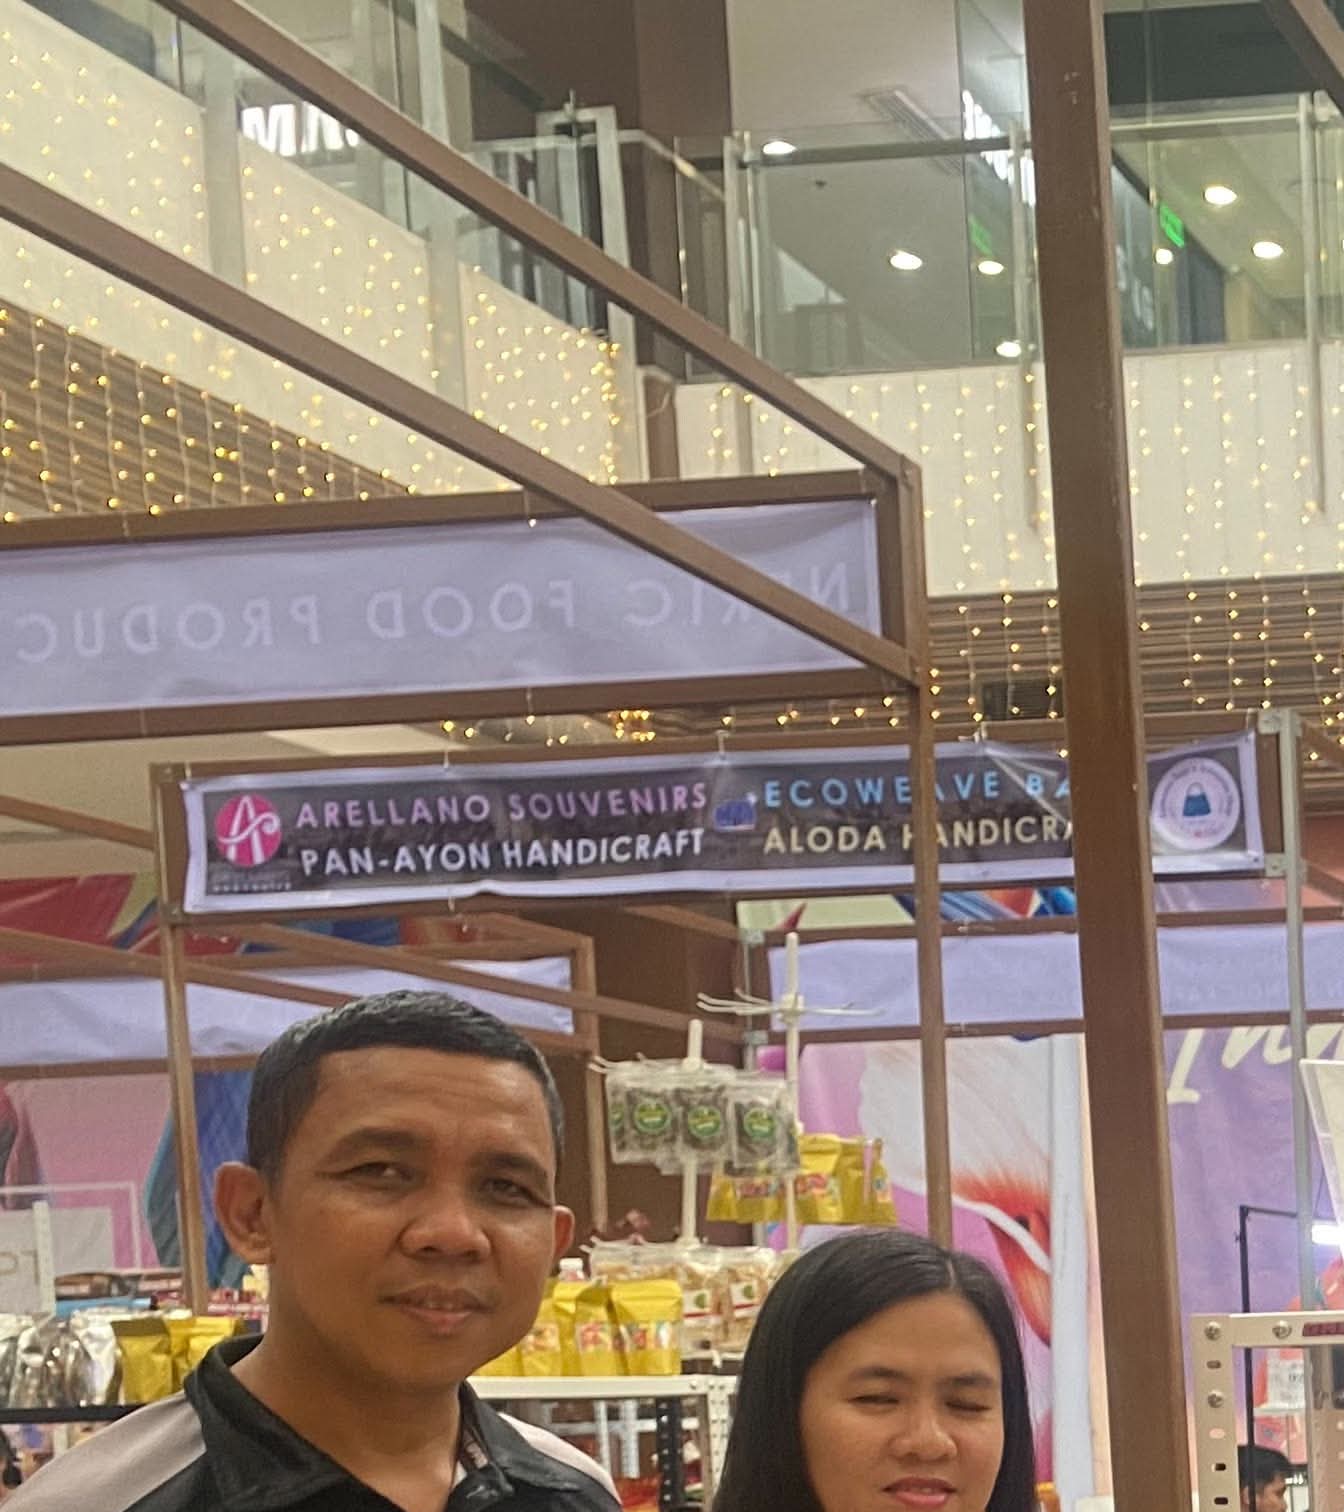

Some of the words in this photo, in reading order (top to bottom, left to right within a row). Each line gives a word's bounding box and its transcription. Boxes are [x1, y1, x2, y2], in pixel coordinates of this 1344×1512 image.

[296, 795, 491, 829] ARELLANO
[508, 783, 707, 821] SOUVENIRS
[300, 841, 491, 877] PAN-AYON
[503, 828, 706, 869] HANDICRAFT
[764, 824, 887, 854] ALODA
